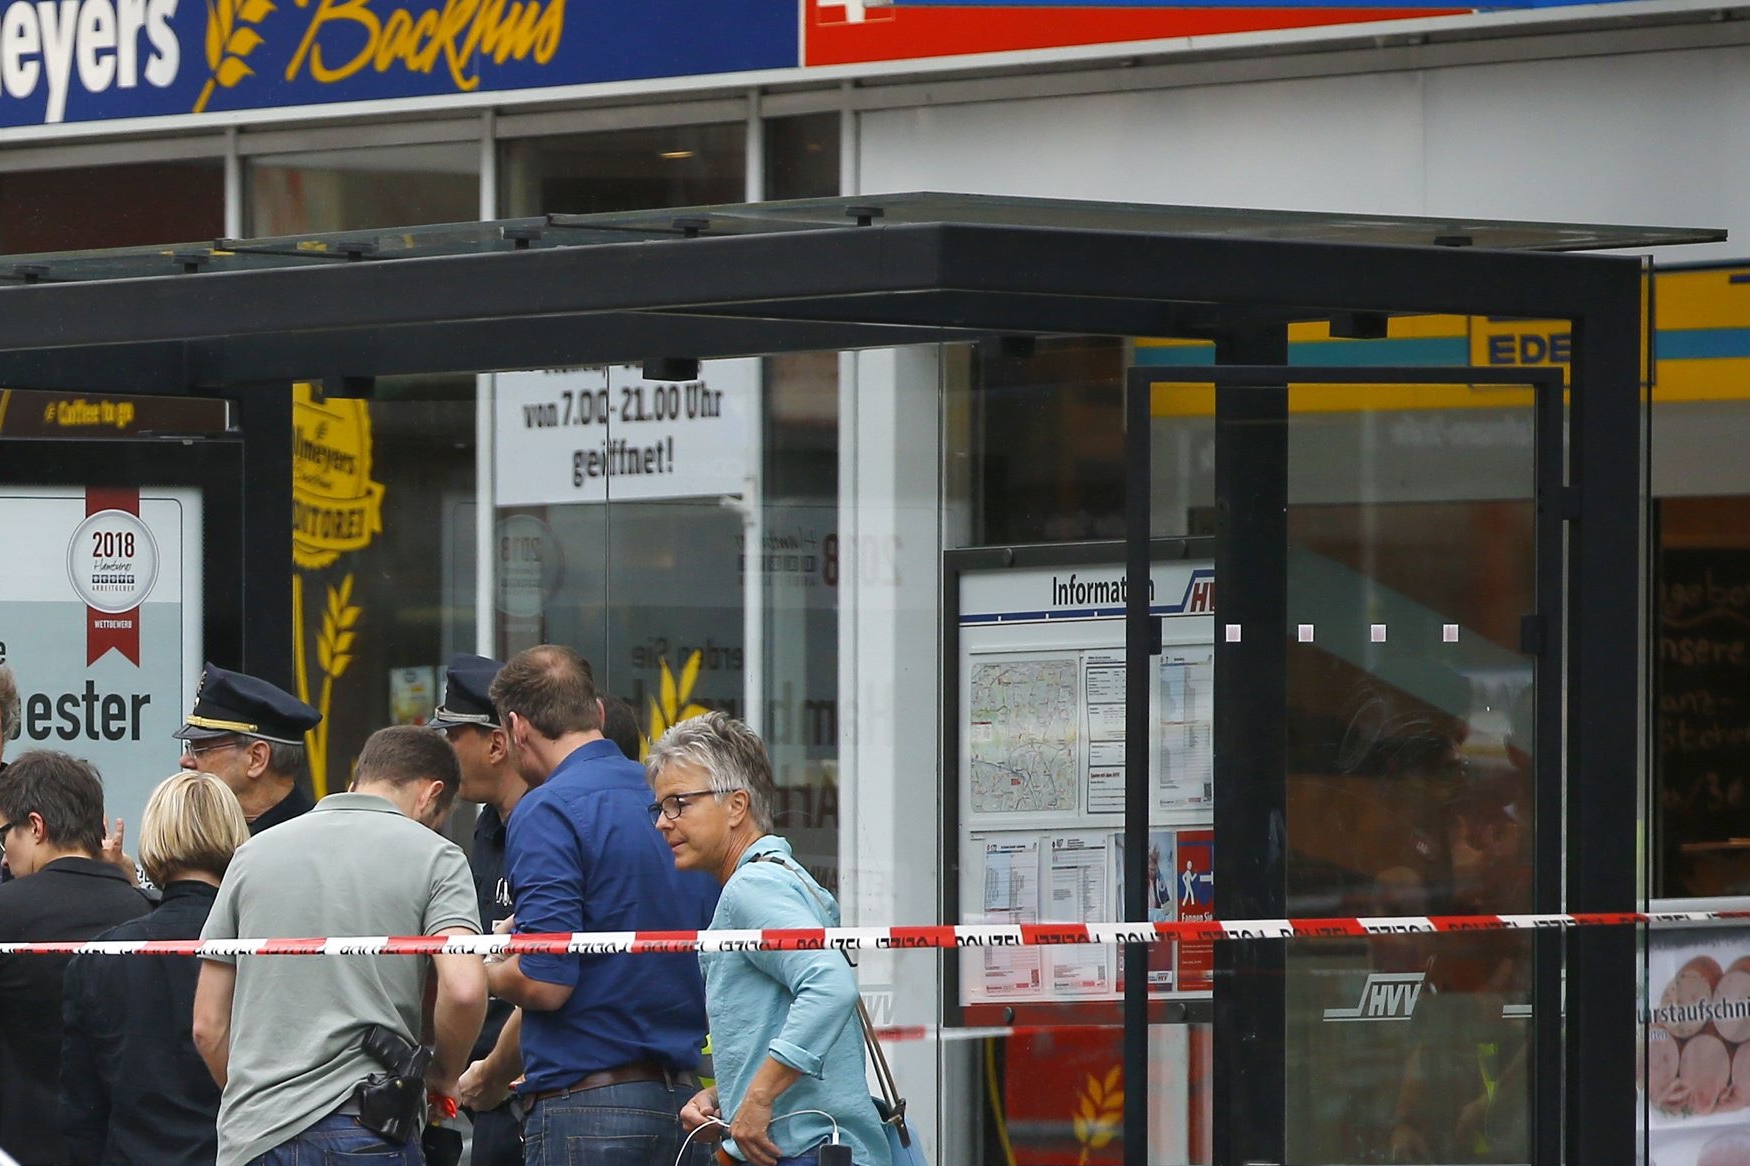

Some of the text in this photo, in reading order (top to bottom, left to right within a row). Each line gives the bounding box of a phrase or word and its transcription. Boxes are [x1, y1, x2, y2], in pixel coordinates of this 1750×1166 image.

[285, 0, 566, 91] Backhus
[1487, 333, 1571, 365] EDE
[523, 402, 557, 428] von
[685, 380, 723, 419] Uhr
[92, 531, 135, 558] 2018
[1368, 984, 1423, 1016] HVV
